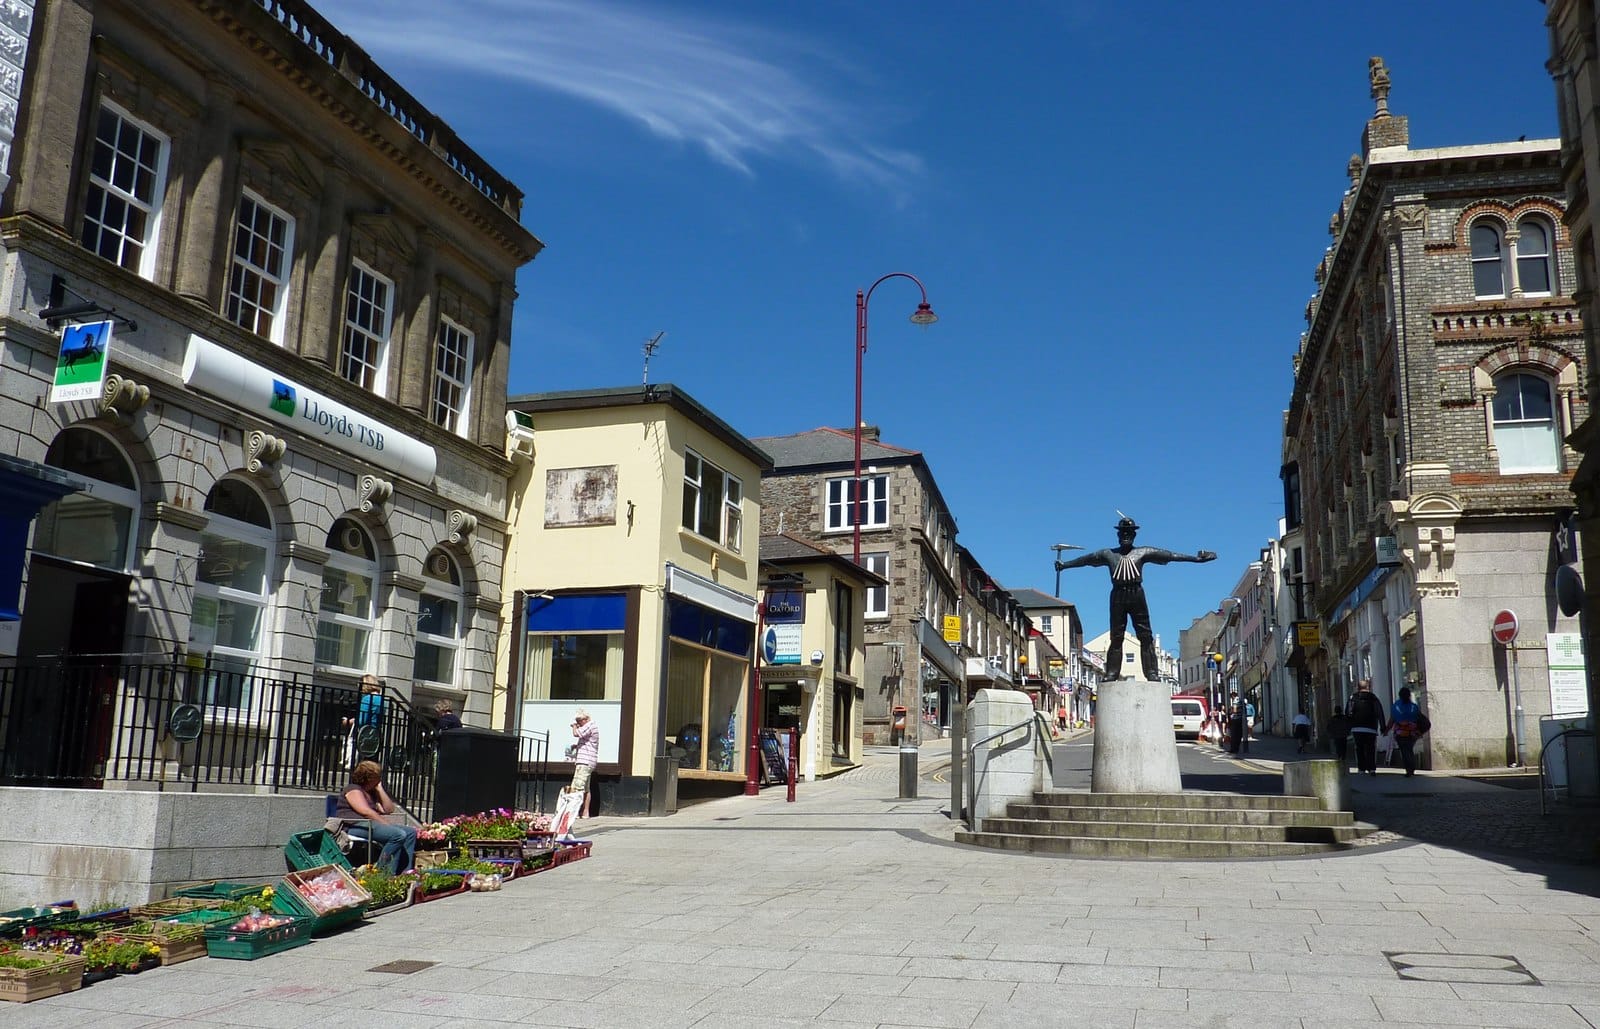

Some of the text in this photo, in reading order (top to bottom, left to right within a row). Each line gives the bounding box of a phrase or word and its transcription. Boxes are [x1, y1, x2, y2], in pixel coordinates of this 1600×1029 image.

[60, 387, 93, 398] Lloyds TSB
[303, 397, 385, 451] Lloyds TSB
[88, 484, 96, 493] 7
[769, 604, 801, 613] OXFORD
